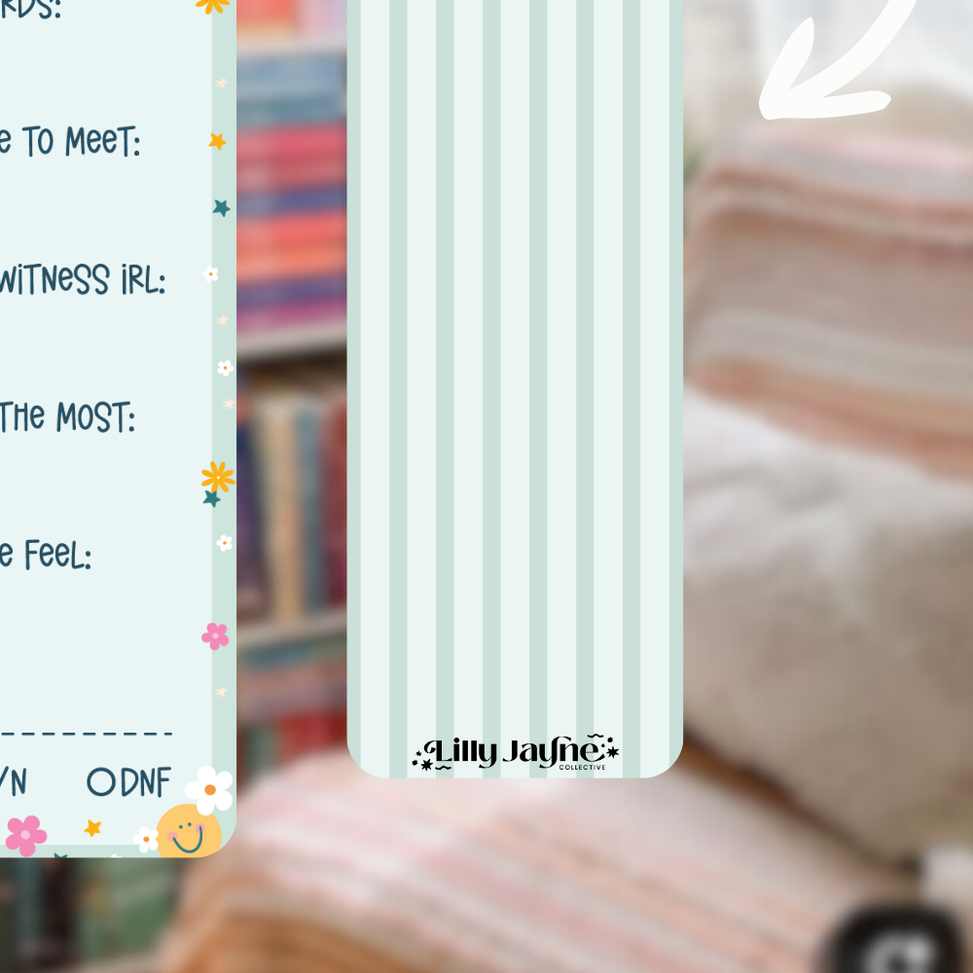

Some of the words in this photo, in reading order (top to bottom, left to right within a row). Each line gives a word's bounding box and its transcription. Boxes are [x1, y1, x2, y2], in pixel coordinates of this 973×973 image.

[21, 125, 54, 158] TO
[56, 400, 136, 434] MOST:
[424, 736, 497, 769] Lilly
[502, 735, 605, 769] Jayne
[121, 766, 172, 799] DNF
